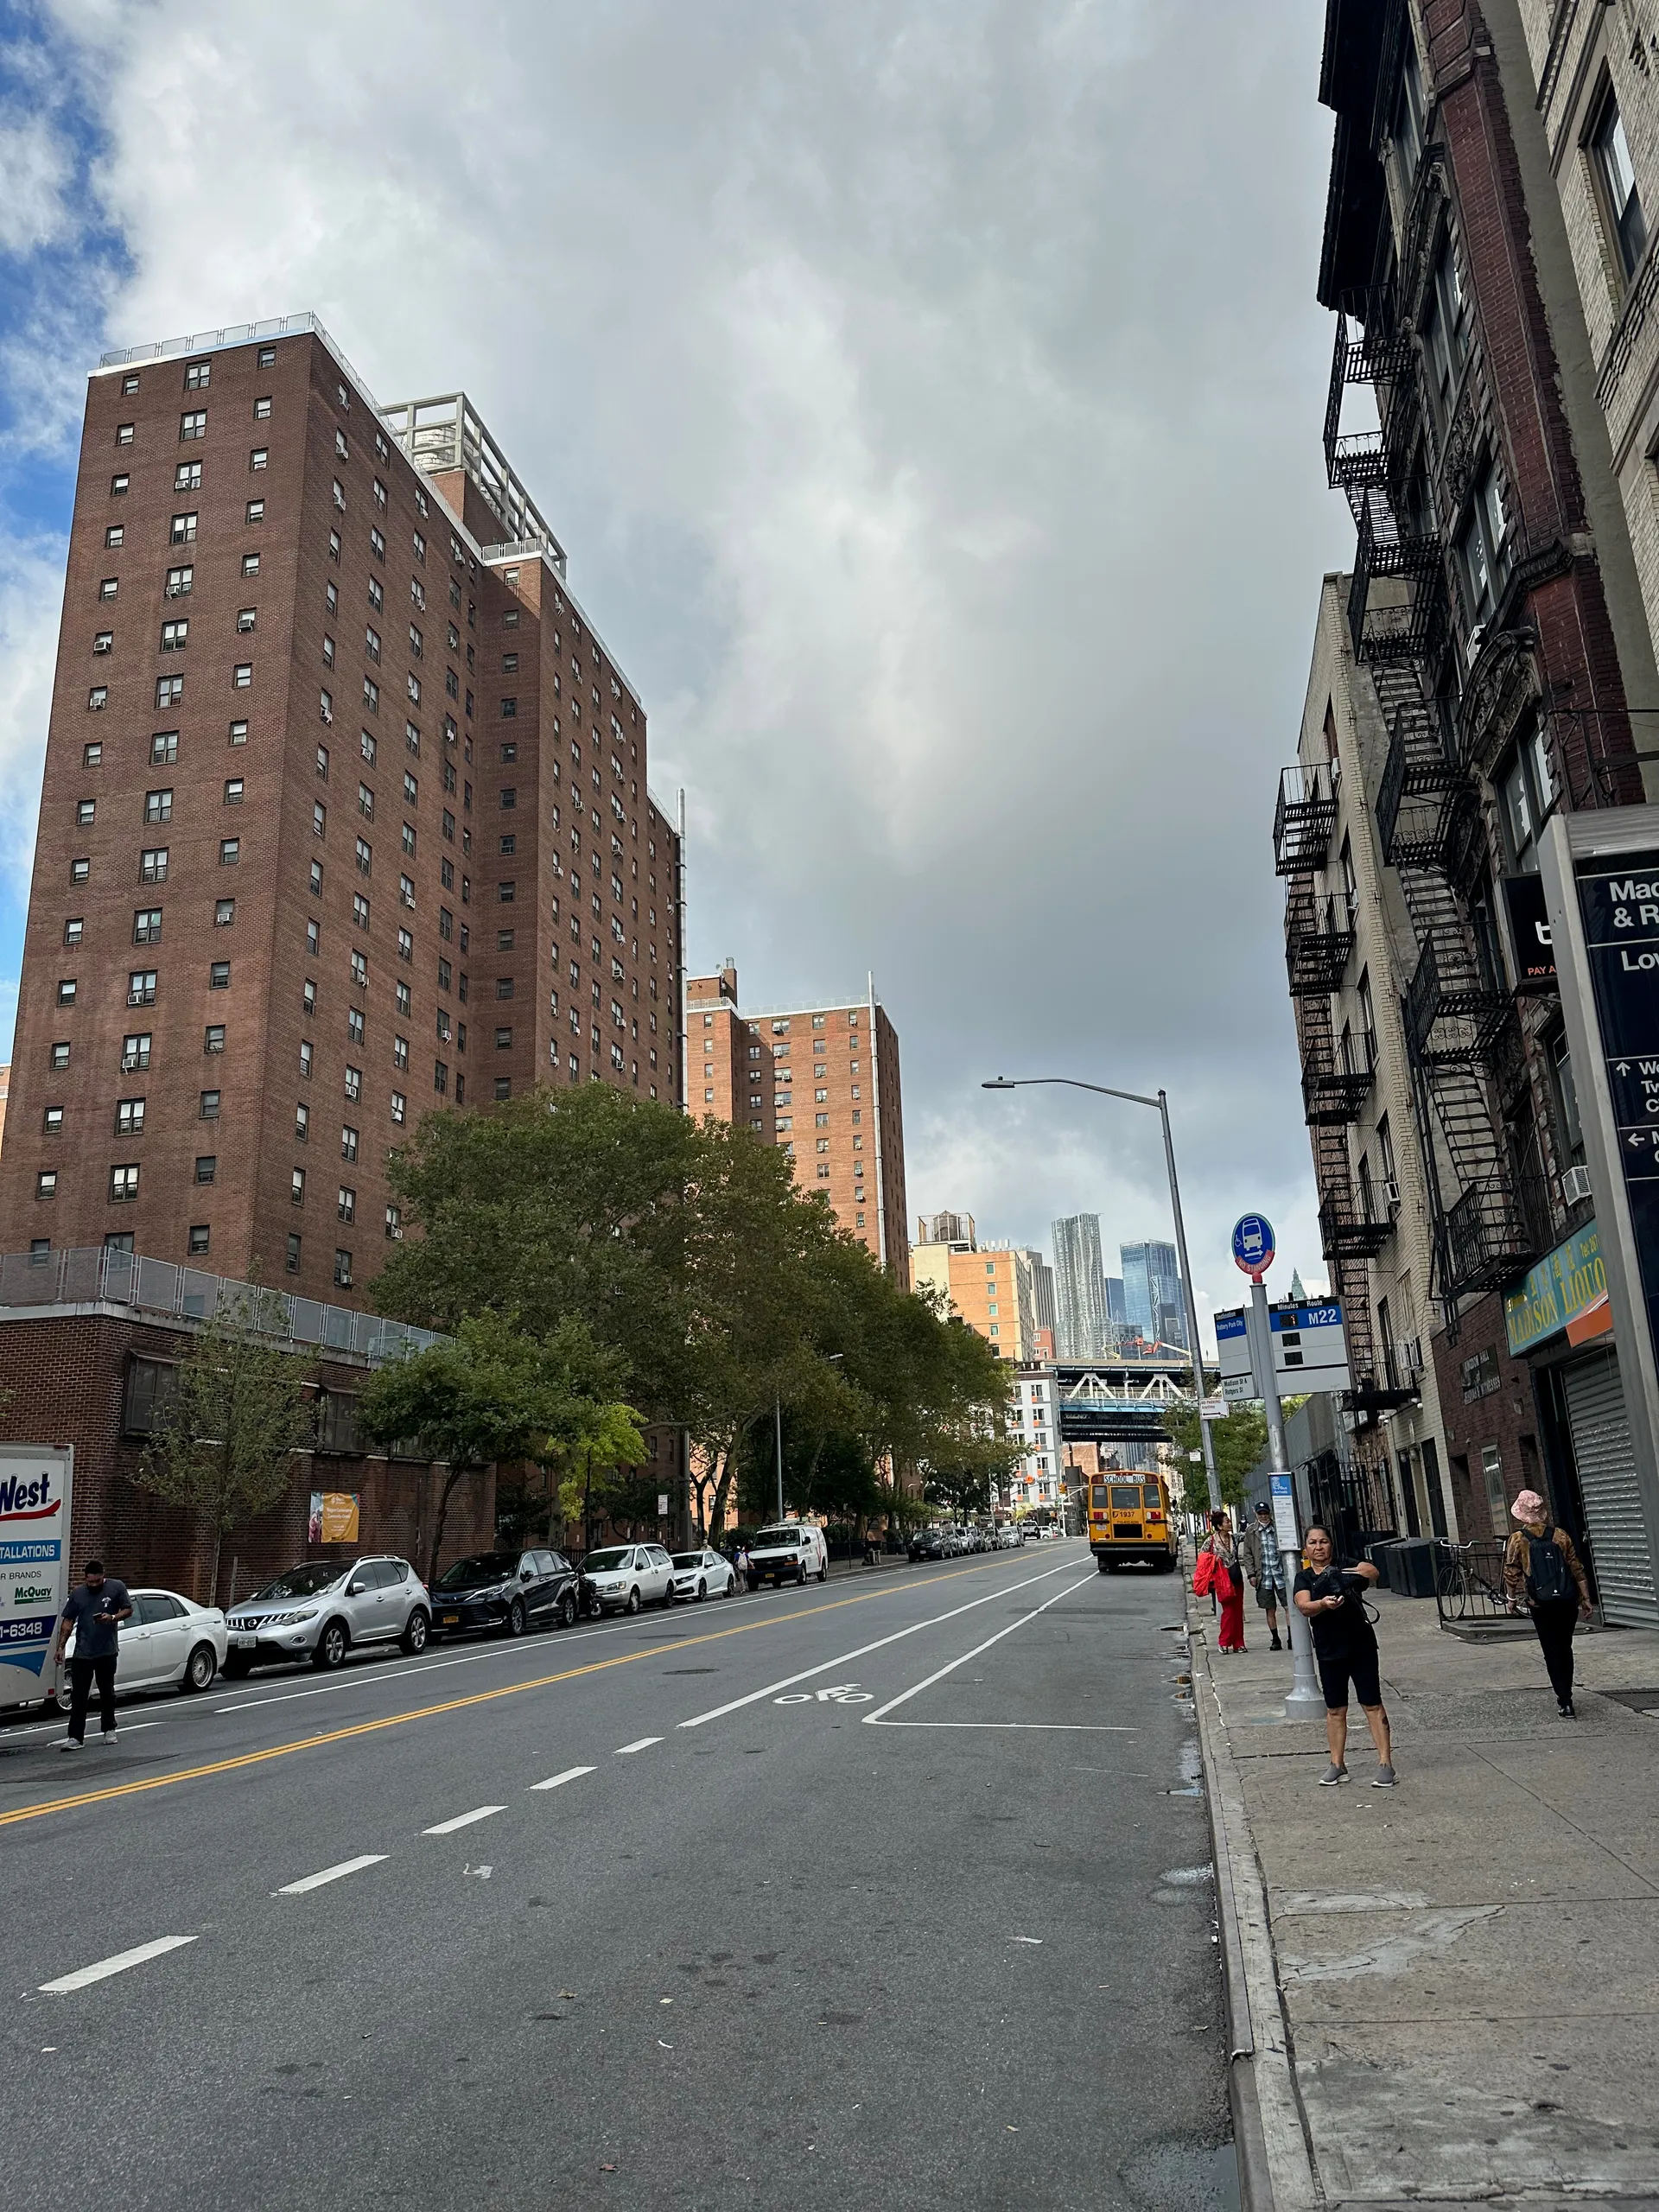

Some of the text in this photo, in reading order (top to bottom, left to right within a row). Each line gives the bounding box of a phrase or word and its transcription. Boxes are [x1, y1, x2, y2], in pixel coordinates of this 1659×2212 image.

[1613, 907, 1635, 927] &
[1528, 966, 1546, 976] PAY
[1247, 1255, 1271, 1272] STANDING
[1308, 1308, 1338, 1325] M22
[1508, 1290, 1559, 1345] MADISON
[9, 1570, 41, 1580] BRANDS
[15, 1586, 52, 1599] McQuay
